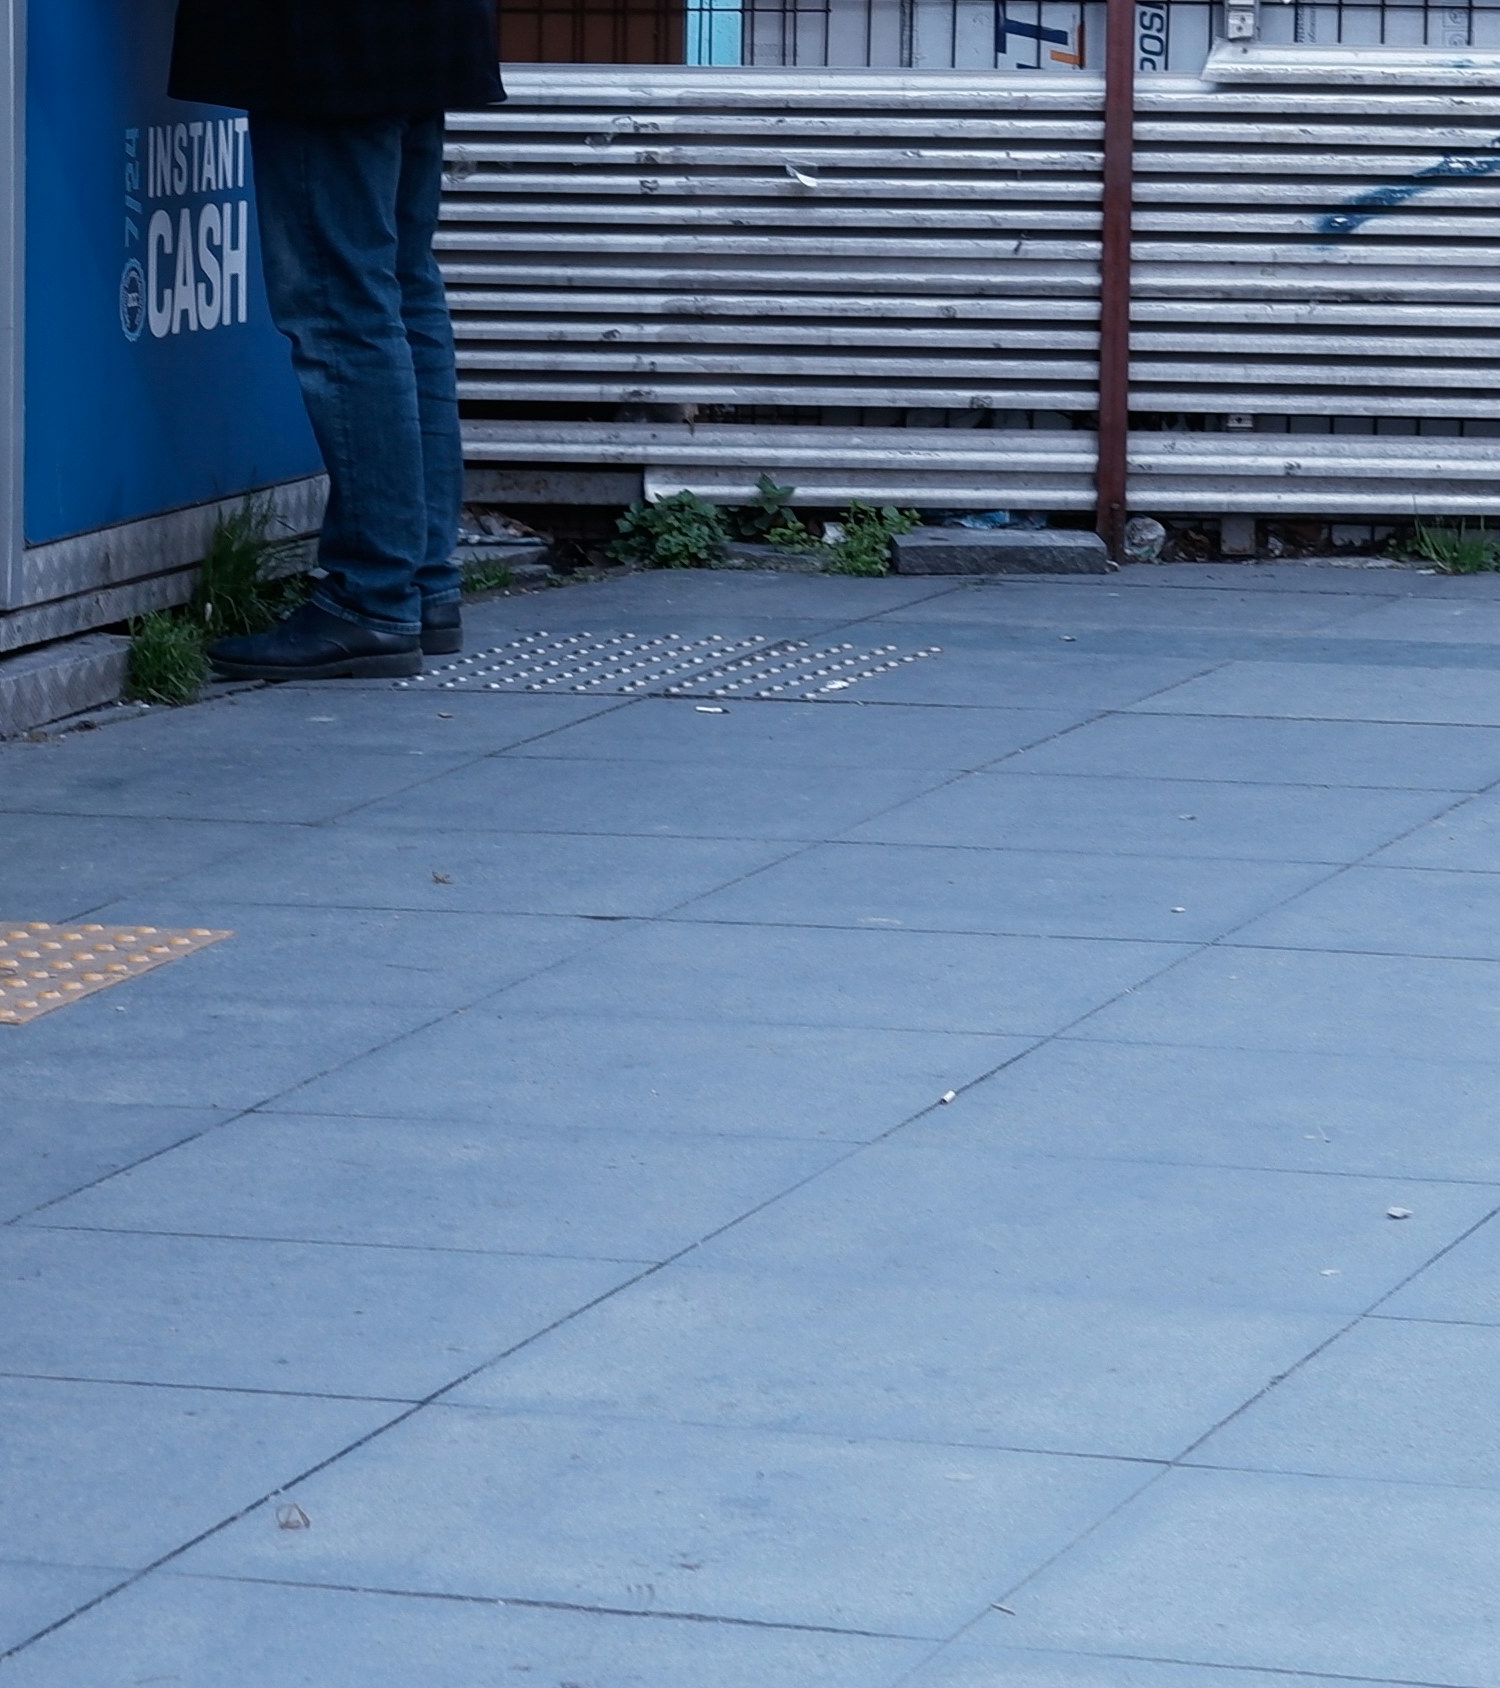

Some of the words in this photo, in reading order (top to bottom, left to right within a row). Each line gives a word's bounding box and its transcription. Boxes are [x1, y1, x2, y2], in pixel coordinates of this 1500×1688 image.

[124, 127, 142, 249] 7/24
[147, 117, 249, 199] INSTANT
[147, 200, 249, 339] CASH
